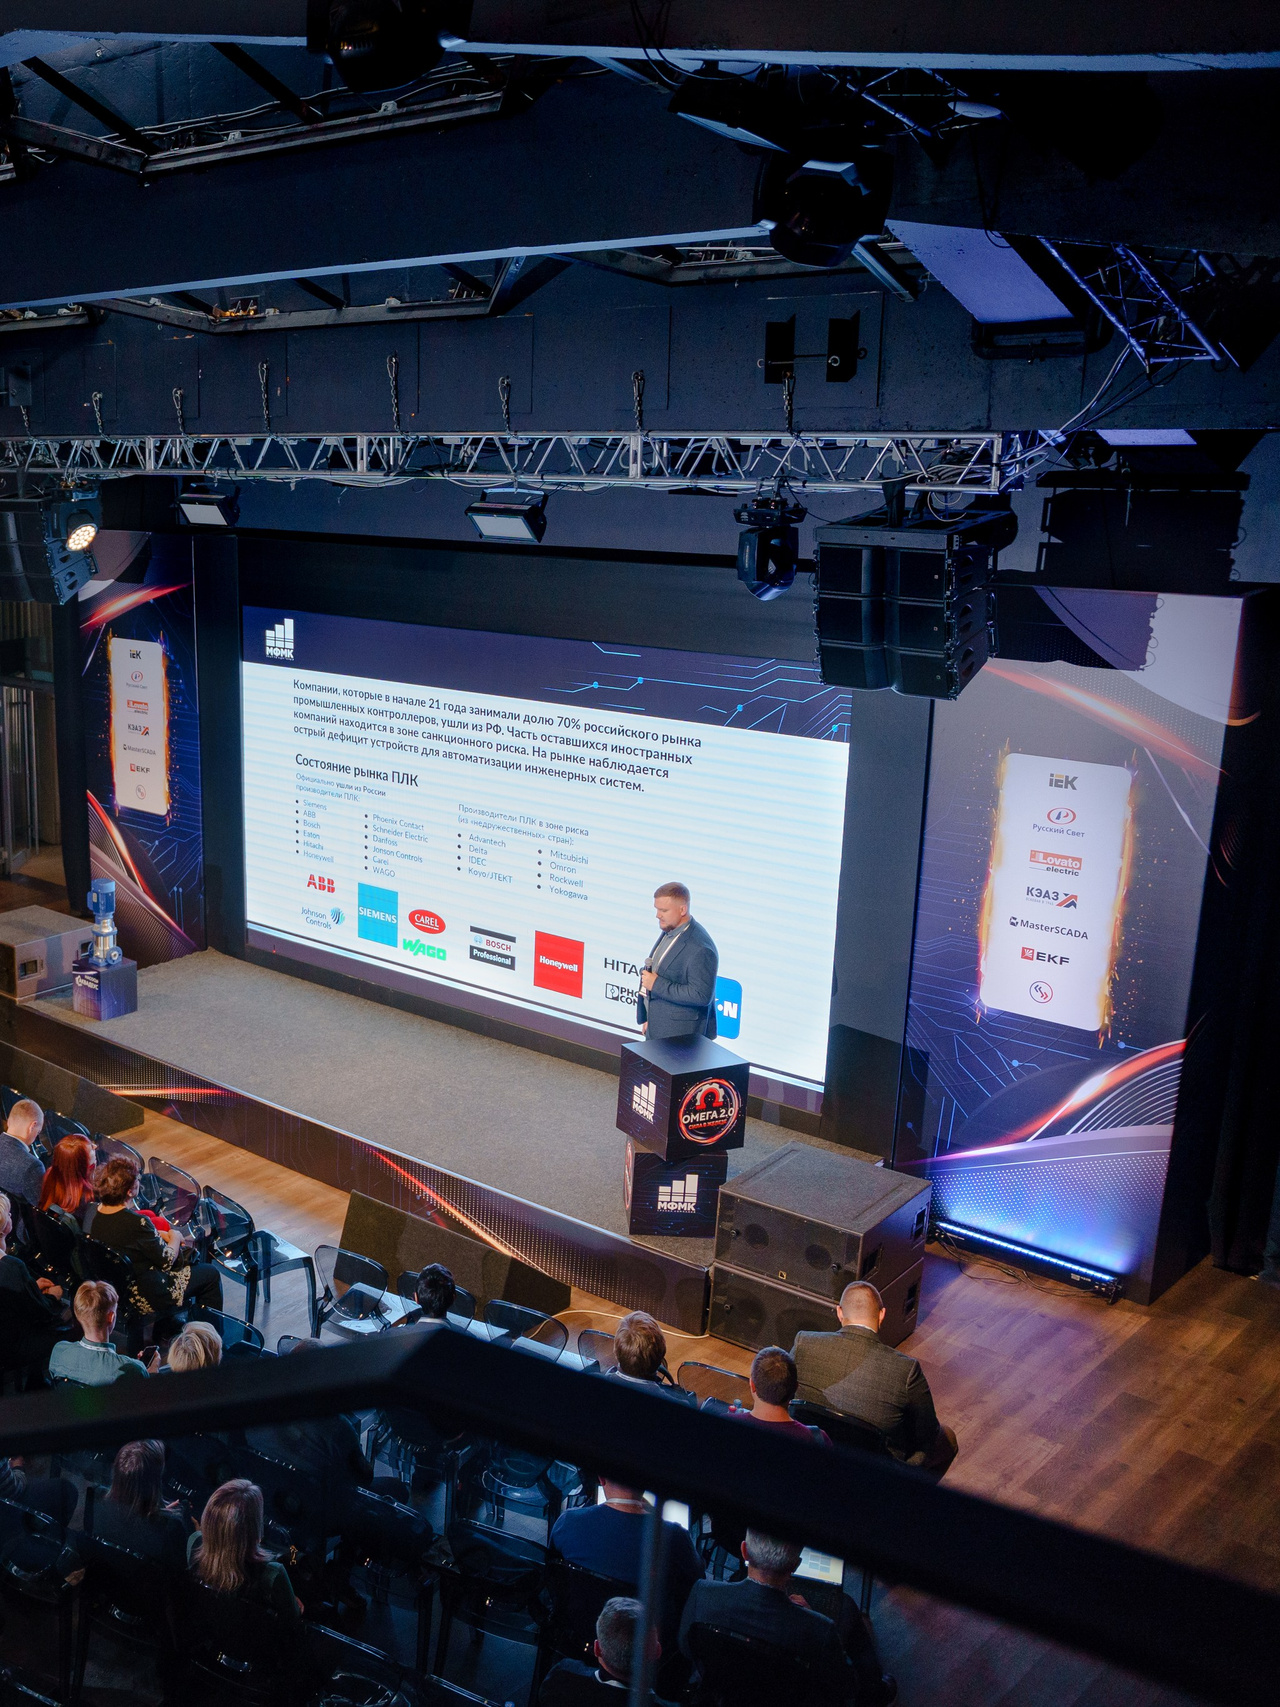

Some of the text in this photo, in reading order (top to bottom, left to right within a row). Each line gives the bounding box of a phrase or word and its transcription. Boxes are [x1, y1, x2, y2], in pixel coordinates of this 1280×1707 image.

[266, 646, 294, 658] МФМК
[293, 679, 702, 748] Компании, которые в начале 21 года занимали долю 70% российского рынка
[293, 696, 693, 765] промышленных контроллеров, ушли из РФ. Часть оставшихся иностранных
[293, 710, 669, 779] компаний находится в зоне санкционного риска. На рынке наблюдается
[293, 724, 645, 793] острый дефицит устройств для автоматизации инженерных систем.
[136, 766, 150, 774] EKF
[295, 753, 419, 788] Состояние рынка ПЛК
[296, 772, 335, 787] Официально
[336, 782, 354, 792] ушли
[363, 786, 386, 798] России
[296, 784, 361, 802] производители ПЛК:
[303, 799, 328, 811] Siemens
[303, 820, 321, 830] Bosch
[372, 813, 425, 831] Phoenix Contact
[458, 804, 589, 837] Производители ПЛК в зоне риска
[303, 830, 320, 840] Eaton
[372, 824, 429, 843] Schneider Electric
[458, 815, 574, 847] (из «недружественных» стран):
[1032, 823, 1085, 838] Русский Свет
[303, 840, 324, 850] Hitachi
[372, 834, 398, 847] Danfoss
[468, 833, 506, 848] Advantech
[303, 850, 334, 864] Honeywell
[372, 846, 423, 864] Jonson Controls
[468, 844, 488, 856] Delta
[550, 850, 589, 865] Mitsubishi
[372, 856, 389, 866] Carel
[468, 856, 487, 867] IDEC
[1035, 851, 1080, 869] Lovato
[372, 866, 396, 878] WAGO
[468, 867, 514, 884] Koyo/JTEKT
[550, 862, 577, 875] Omron
[1046, 866, 1080, 877] electric
[306, 874, 336, 894] ABB
[549, 874, 584, 888] Rockwell
[549, 885, 588, 901] Yokogawa
[1026, 886, 1060, 902] КЭАЗ
[301, 906, 327, 920] Johnson
[358, 906, 398, 924] SIEMENS
[305, 916, 332, 930] Controls
[414, 914, 440, 928] CAREL
[1020, 919, 1088, 940] MasterSCADA
[402, 938, 446, 961] WAGO
[485, 938, 512, 952] BOSCH
[472, 948, 512, 966] Professional
[539, 955, 578, 973] Honeywell
[1036, 952, 1070, 966] EKF
[604, 958, 640, 977] HITA
[620, 986, 639, 998] PHO
[620, 996, 638, 1007] CON
[632, 1101, 654, 1121] МФМК
[682, 1108, 734, 1124] ОМЕГА 2.0
[658, 1202, 696, 1211] МФМК
